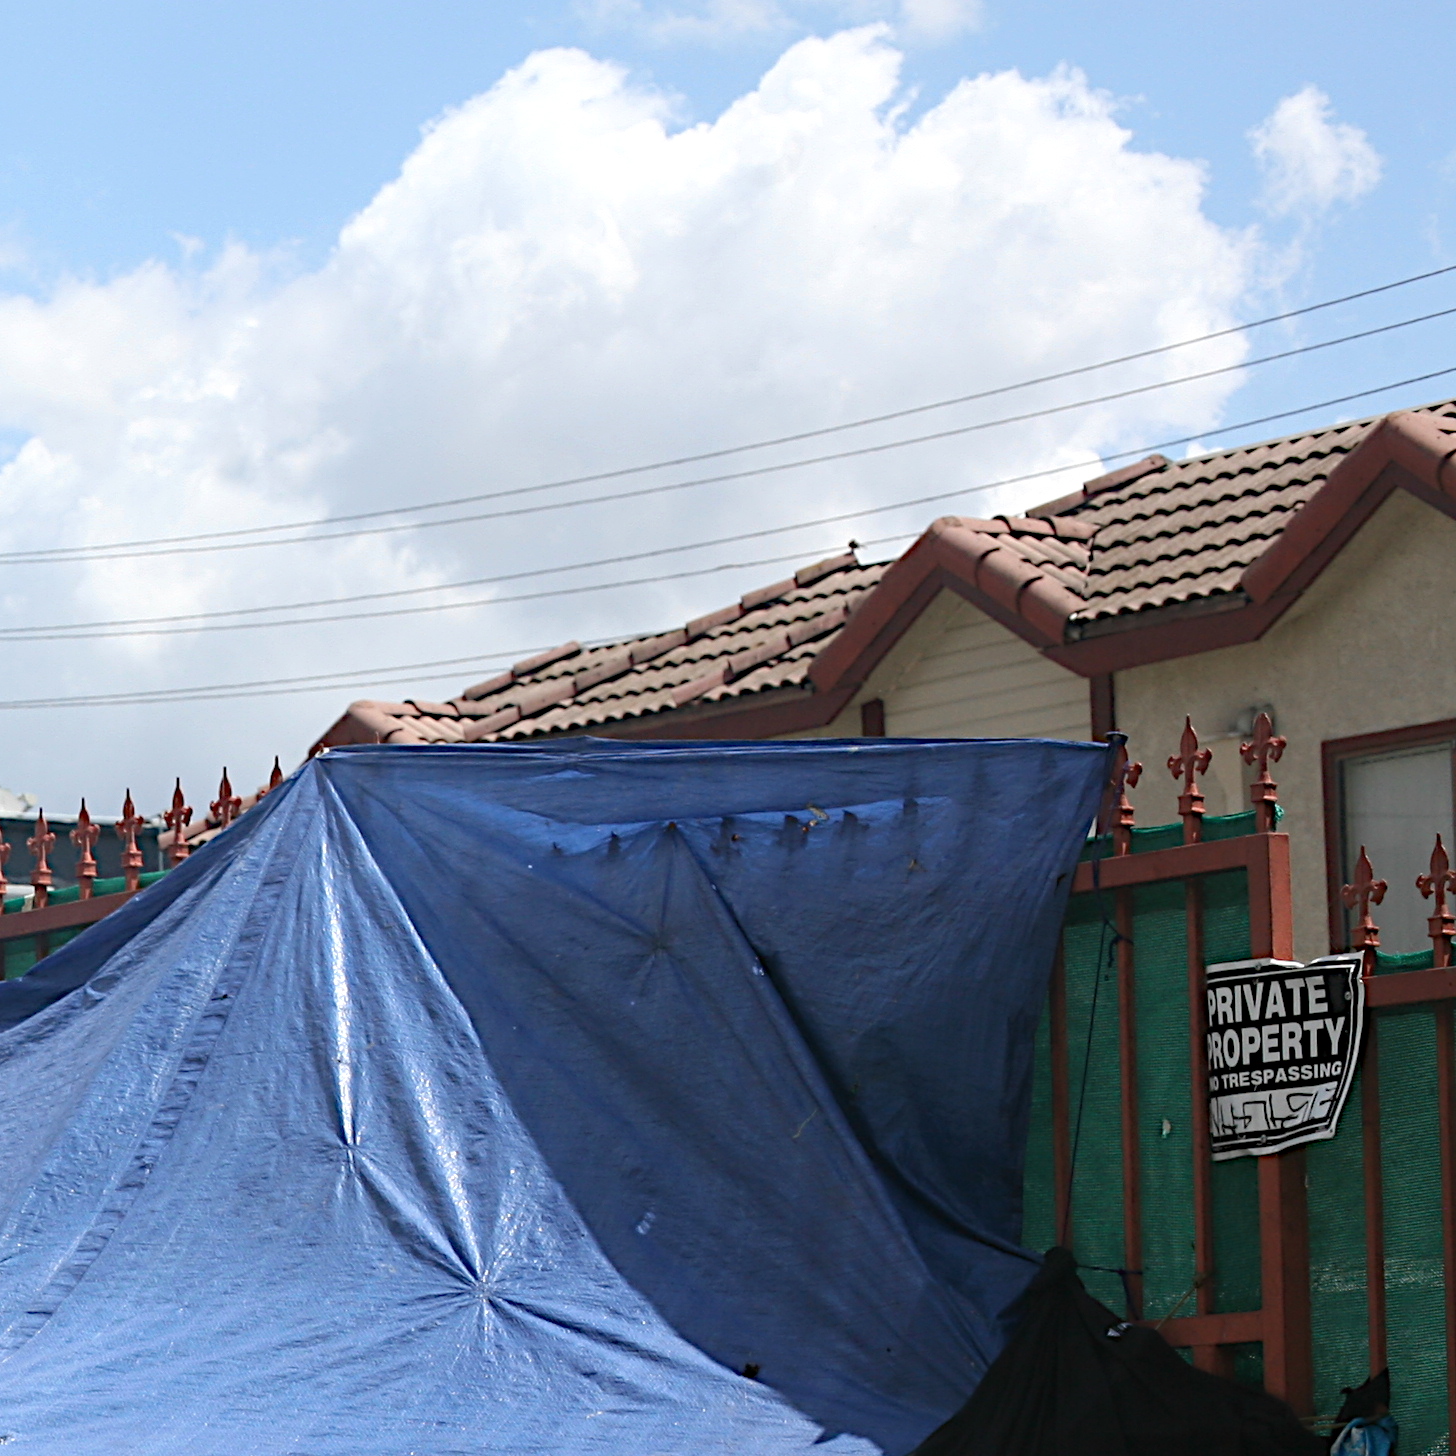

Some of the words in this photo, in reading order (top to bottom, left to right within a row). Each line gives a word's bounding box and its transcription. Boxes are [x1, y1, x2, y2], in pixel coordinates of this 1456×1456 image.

[1207, 976, 1329, 1027] PRIVATE
[1207, 1016, 1346, 1070] PROPERTY
[1220, 1061, 1343, 1090] TRESPASSING
